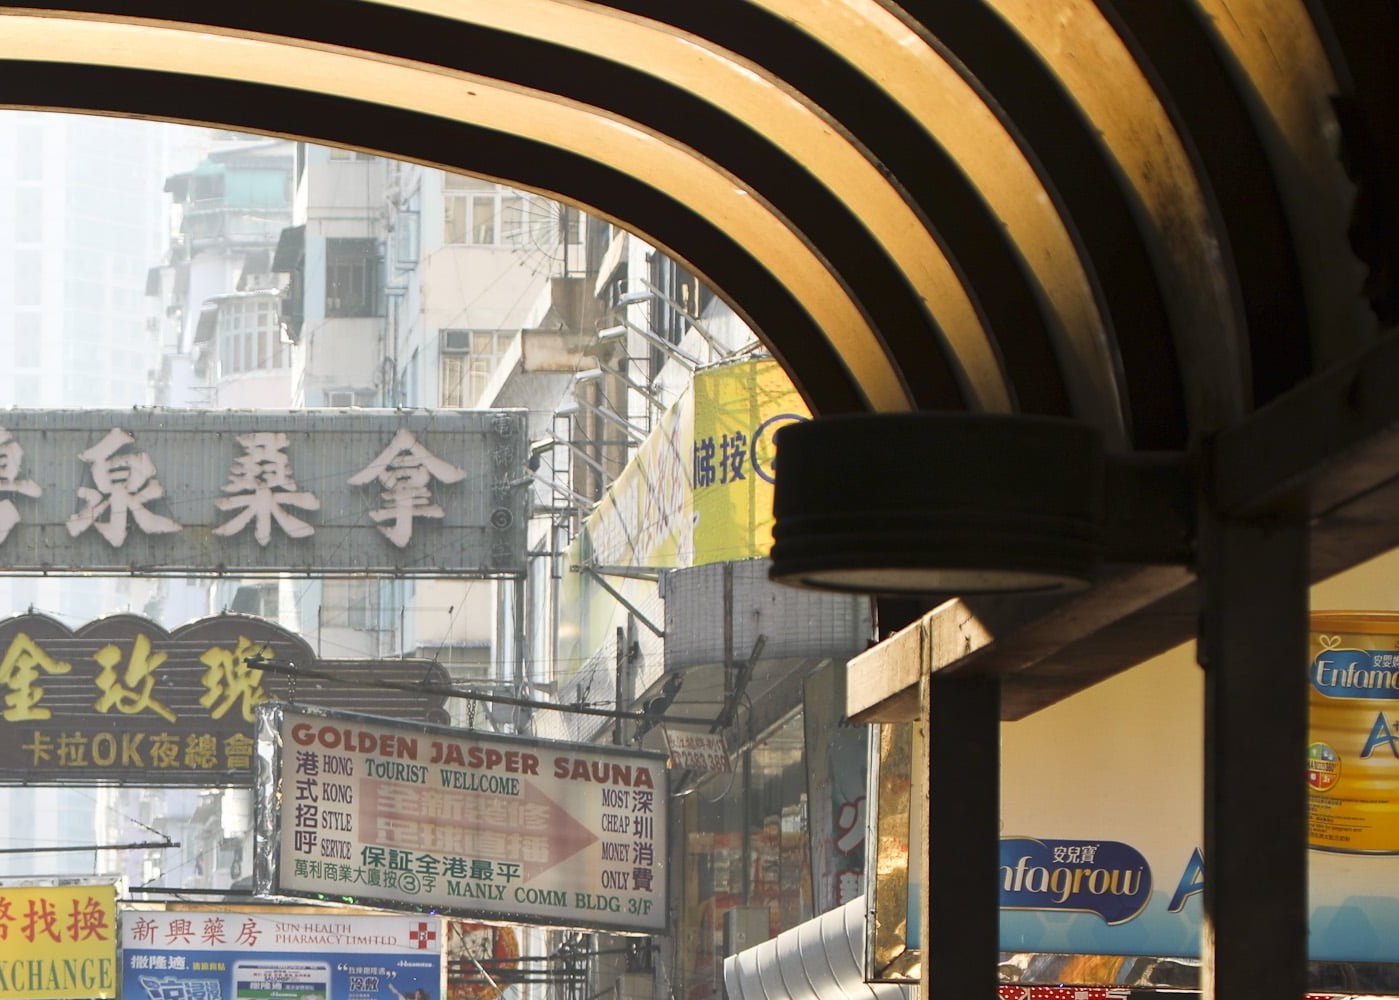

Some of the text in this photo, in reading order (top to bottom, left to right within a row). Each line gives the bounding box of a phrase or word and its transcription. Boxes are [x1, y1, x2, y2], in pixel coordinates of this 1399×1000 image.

[21, 731, 255, 769] 卡拉OK夜總會
[291, 723, 654, 789] GOLDEN JASPER SAUNA
[323, 754, 353, 776] HONG
[365, 757, 520, 796] TOURIST WELLCOME
[294, 750, 319, 855] 港式招呼
[322, 782, 353, 804] KONG
[602, 788, 630, 808] MOST
[321, 810, 352, 832] STYLE
[601, 813, 630, 834] CHEAP
[320, 838, 352, 860] SERVICE
[601, 841, 630, 863] MONEY
[631, 790, 654, 893] 深圳消費
[360, 845, 521, 884] 保証全港最平
[1052, 845, 1096, 865] 安兒寶
[601, 870, 629, 891] ONLY
[1000, 857, 1145, 903] nfagrow
[446, 880, 653, 916] MANLY COMM BLDG 3/F
[130, 917, 264, 947] 新興藥房
[274, 923, 352, 935] SUN HEALTH
[274, 934, 398, 947] PHARMACY LIMITED
